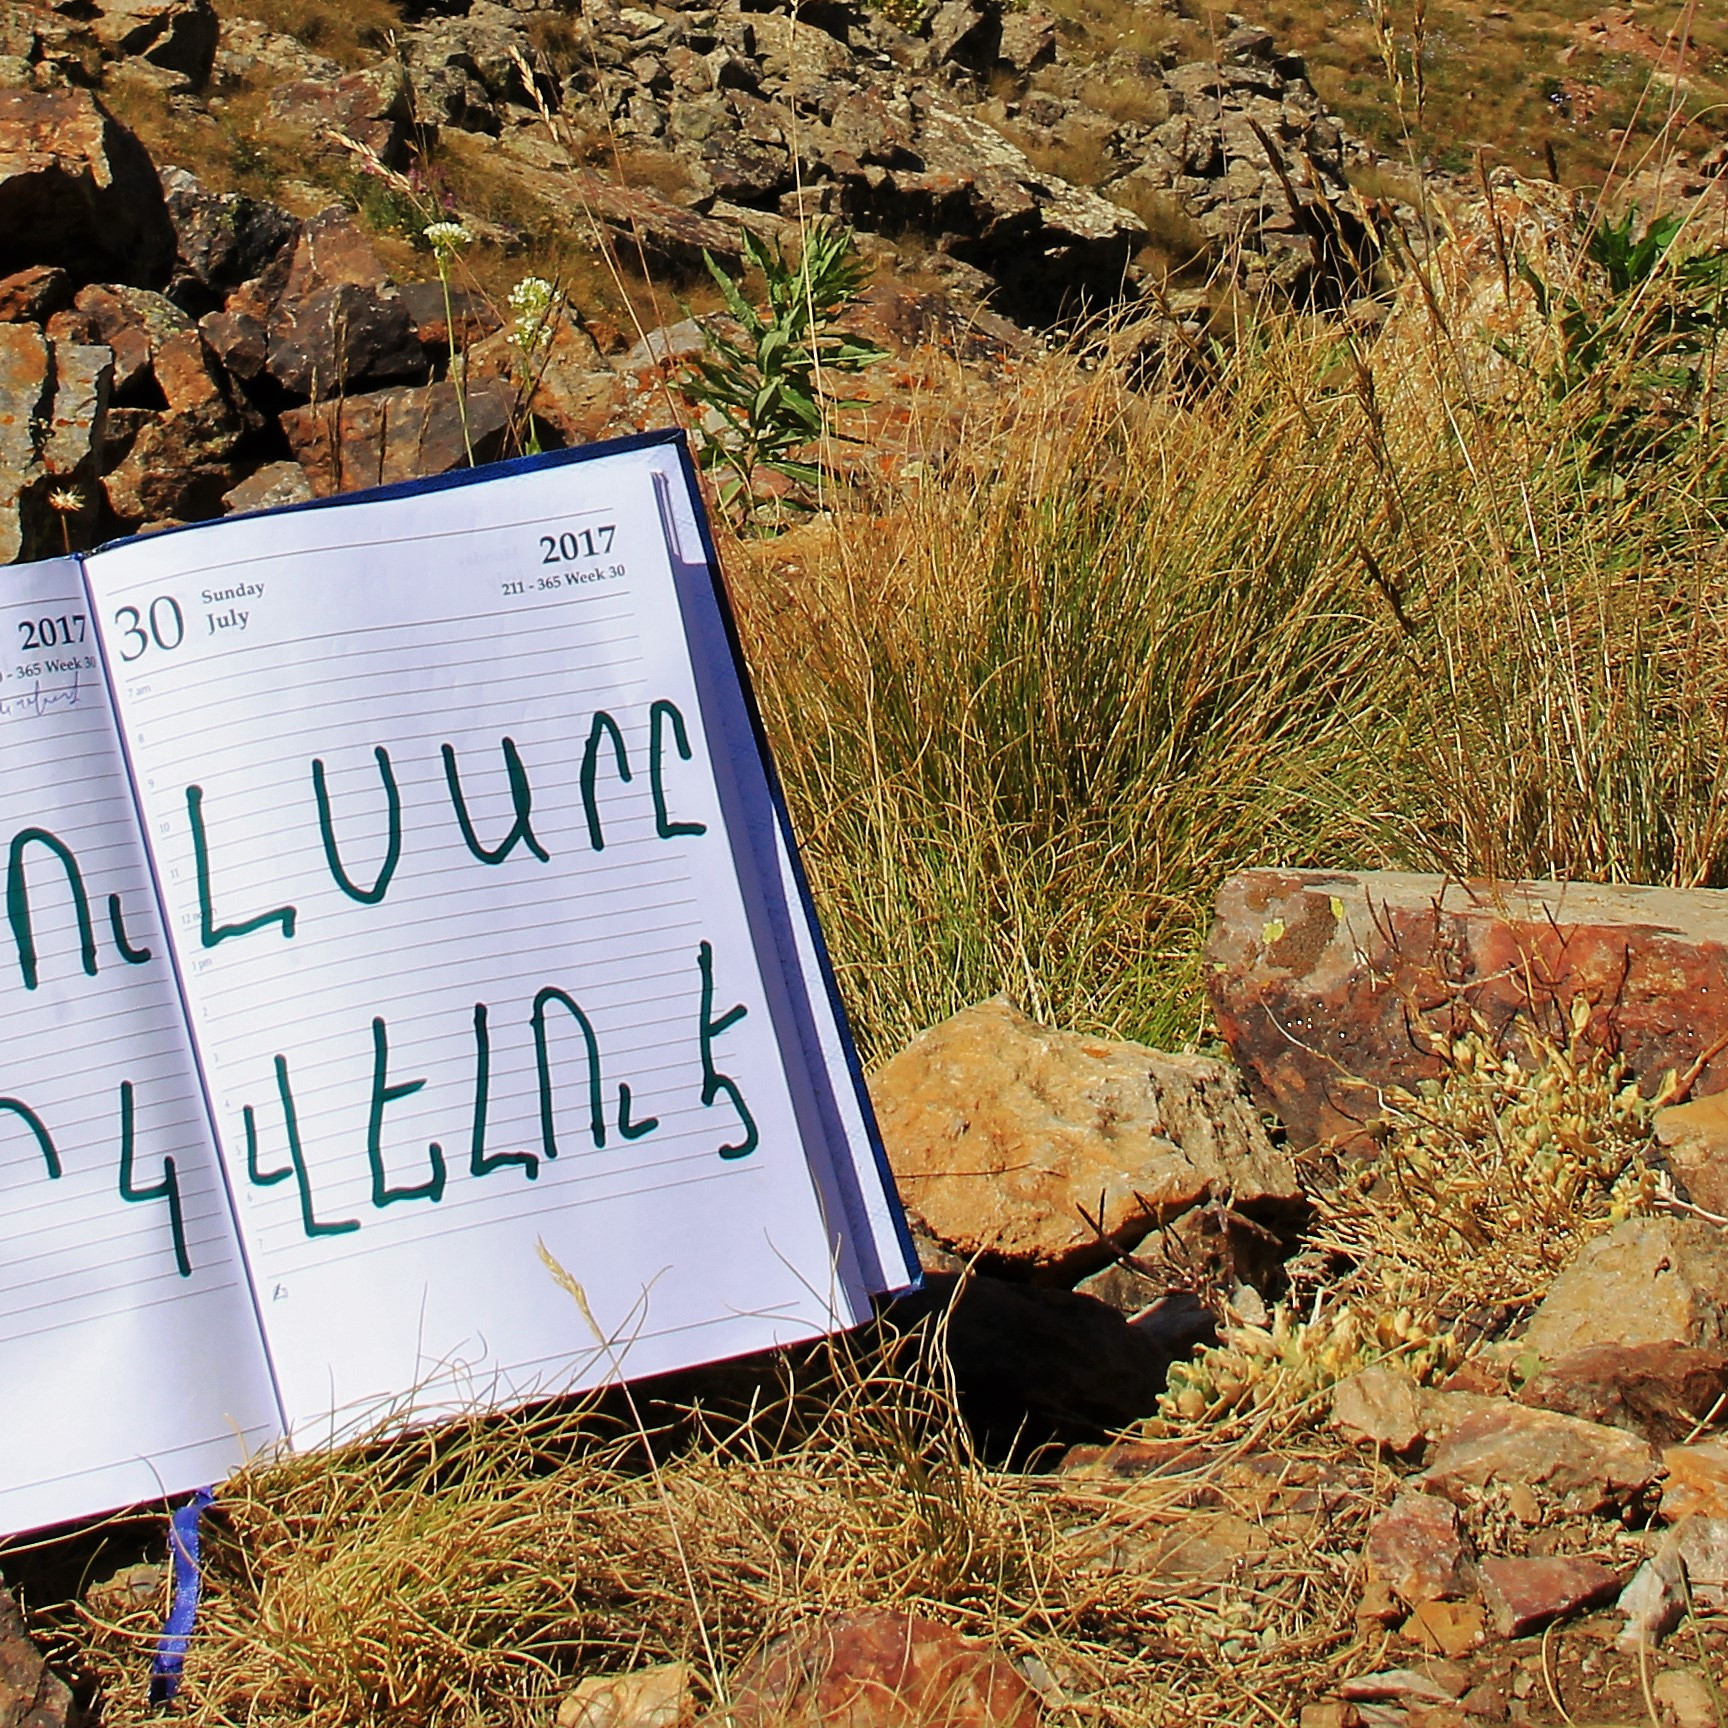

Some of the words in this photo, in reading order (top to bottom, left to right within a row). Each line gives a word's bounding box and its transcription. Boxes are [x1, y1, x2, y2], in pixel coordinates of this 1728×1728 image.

[539, 524, 617, 565] 2017
[200, 583, 265, 604] Sunday
[502, 581, 525, 596] 211
[537, 576, 562, 591] 365
[565, 568, 606, 586] Week
[609, 564, 626, 579] 30
[17, 614, 87, 651] 2017
[113, 594, 185, 662] 30
[206, 608, 250, 636] July
[16, 662, 42, 680] 365
[45, 657, 83, 673] Week
